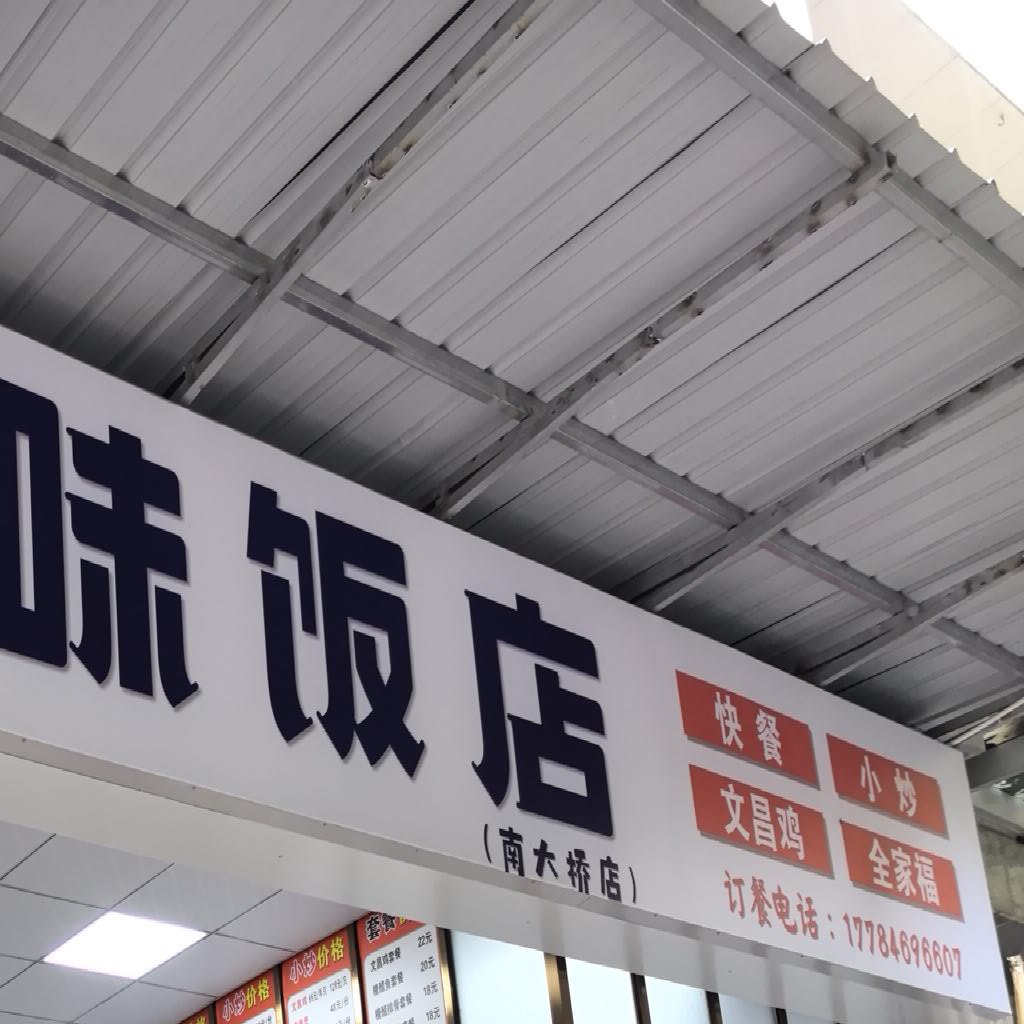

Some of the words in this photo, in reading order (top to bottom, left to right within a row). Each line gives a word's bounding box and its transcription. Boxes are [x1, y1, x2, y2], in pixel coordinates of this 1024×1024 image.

[714, 691, 784, 769] 快餐
[859, 755, 918, 819] 小炒
[719, 782, 806, 862] 文昌鸡
[867, 838, 941, 908] 全家福
[416, 929, 432, 949] 22元
[419, 954, 435, 973] 20元
[422, 979, 438, 998] 18元
[425, 1005, 440, 1023] 18元
